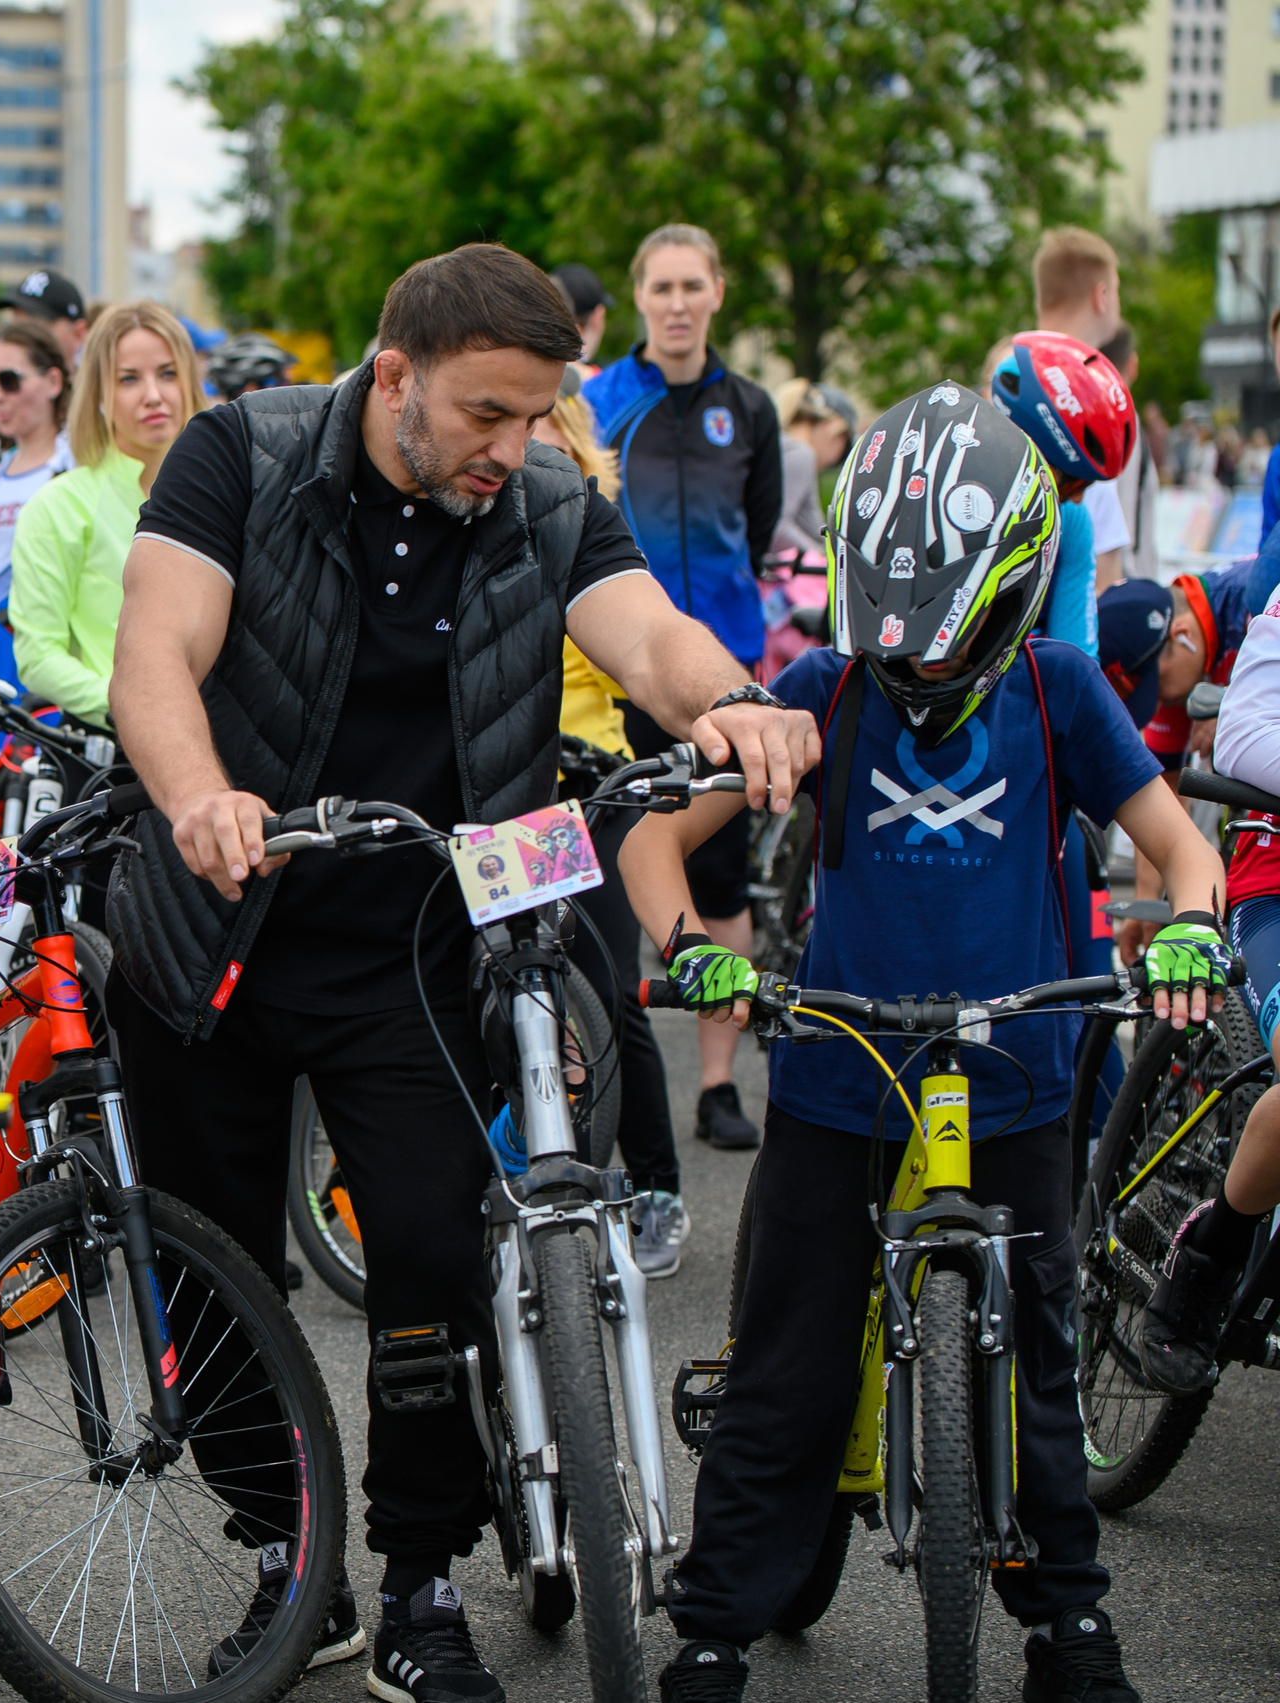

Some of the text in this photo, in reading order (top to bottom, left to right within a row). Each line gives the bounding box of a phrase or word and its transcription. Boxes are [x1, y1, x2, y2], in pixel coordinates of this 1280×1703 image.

[1036, 402, 1080, 462] ESSEN
[944, 608, 959, 631] MY
[874, 851, 934, 865] SINCE
[488, 884, 510, 900] 84
[1130, 1261, 1158, 1291] ROCKBRO
[436, 1594, 458, 1604] adidas
